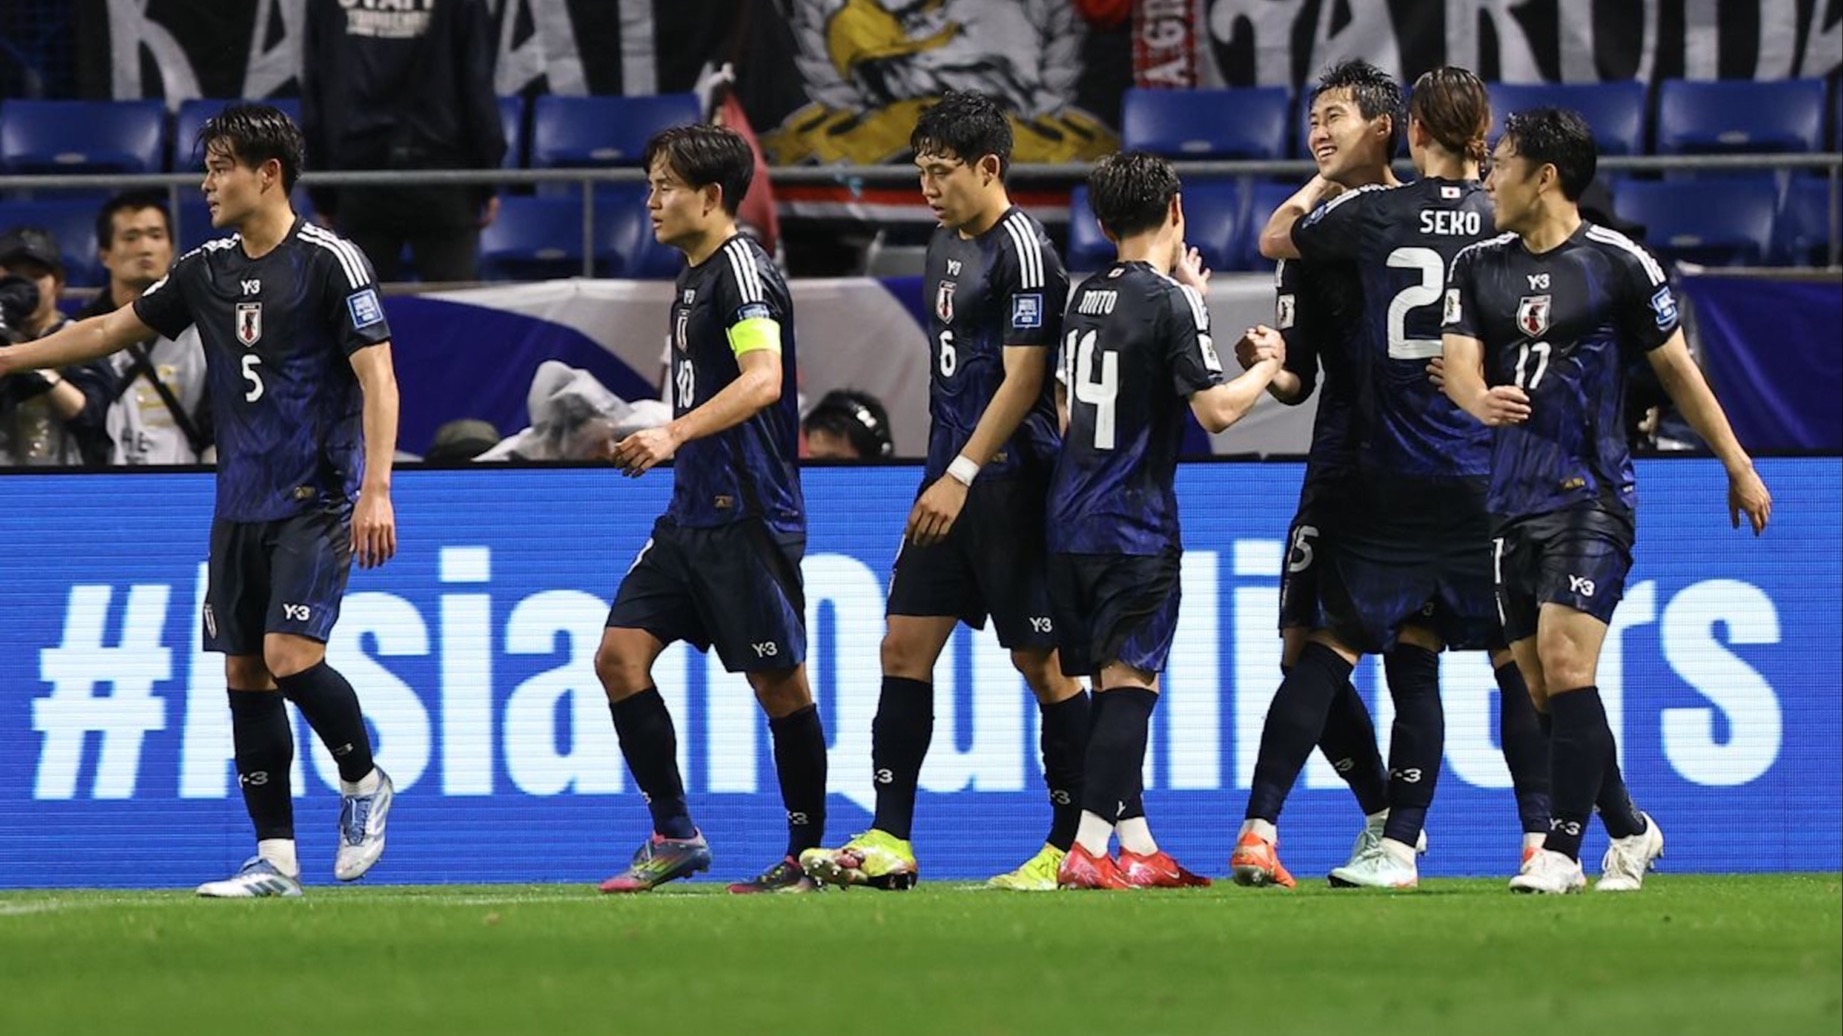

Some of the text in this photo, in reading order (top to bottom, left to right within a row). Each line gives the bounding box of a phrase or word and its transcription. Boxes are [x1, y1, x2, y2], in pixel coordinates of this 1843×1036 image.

[1419, 209, 1481, 236] SEKO
[1078, 290, 1118, 315] MITO
[241, 354, 264, 402] 5
[939, 331, 957, 377] 6
[1515, 341, 1552, 389] 17
[676, 360, 695, 408] 10
[1066, 328, 1119, 449] 14
